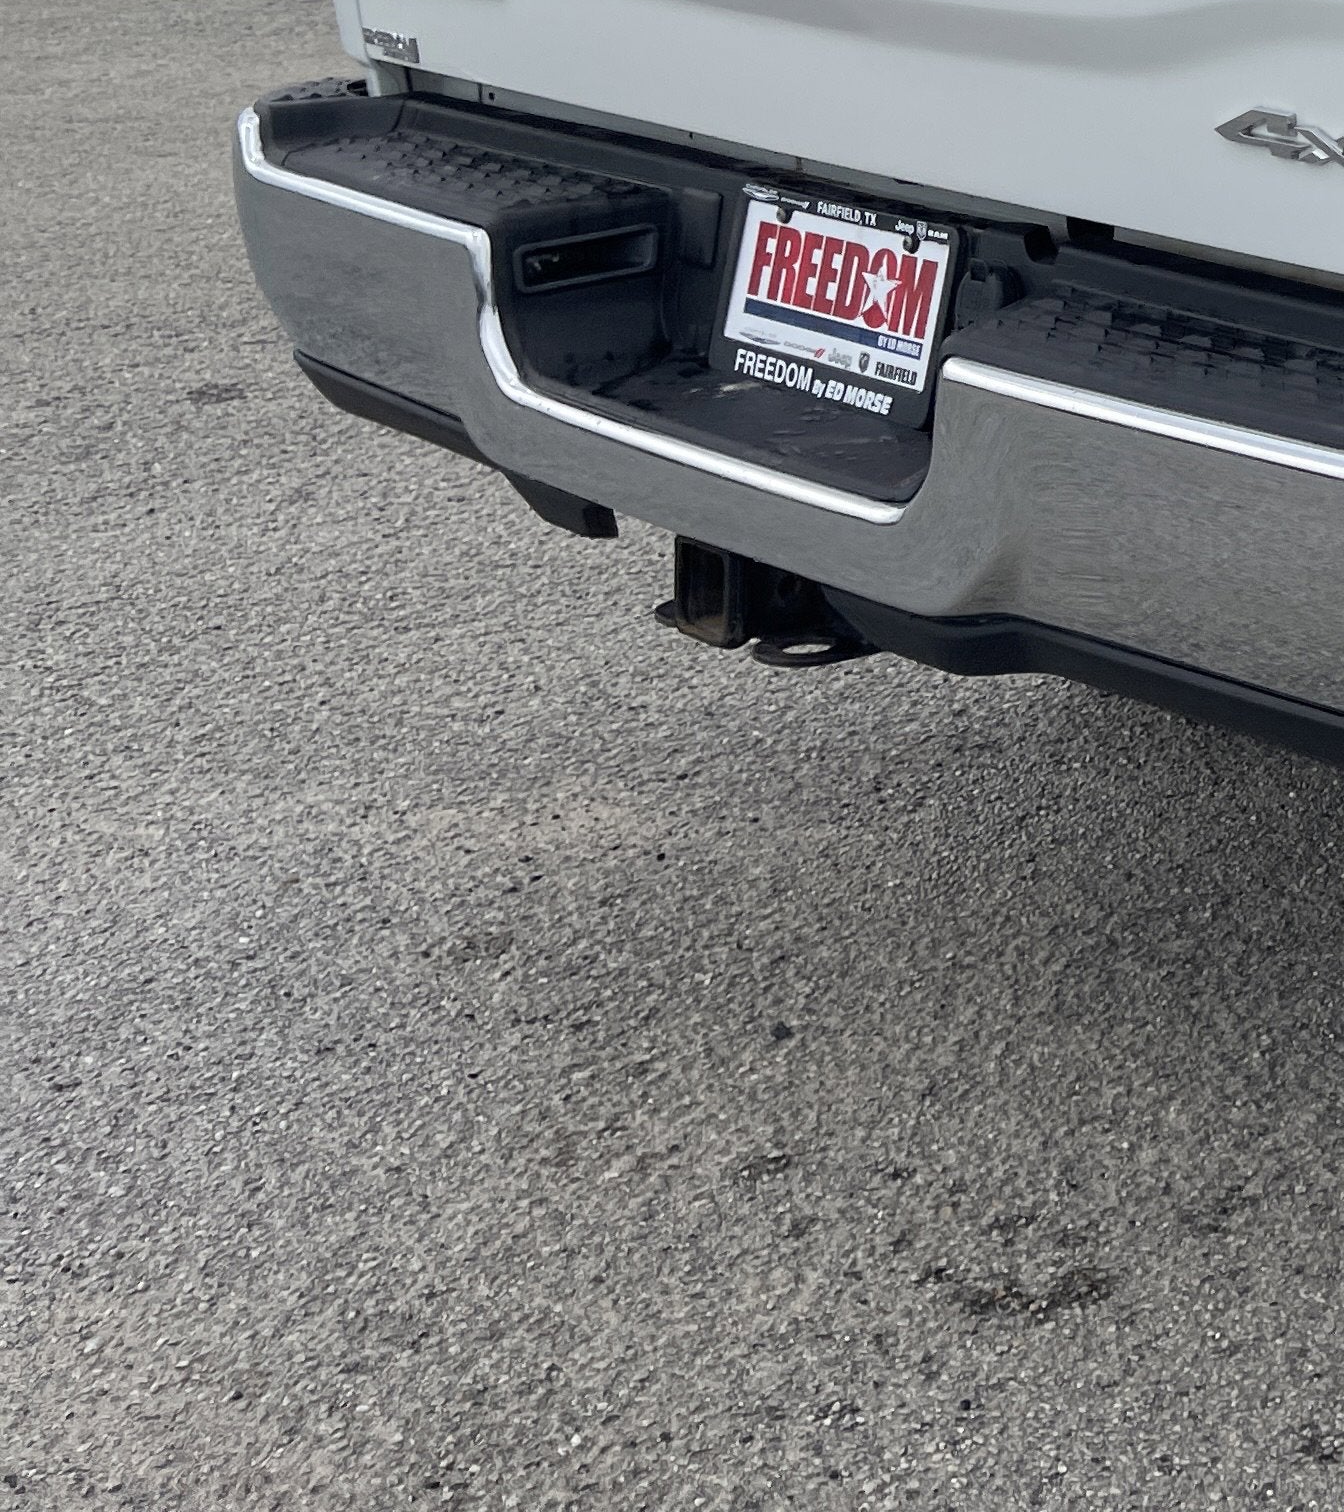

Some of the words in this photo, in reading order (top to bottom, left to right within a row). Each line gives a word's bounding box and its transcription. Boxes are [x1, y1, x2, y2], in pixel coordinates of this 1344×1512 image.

[816, 201, 863, 226] FAIRFIELD,
[864, 211, 877, 227] TX
[894, 219, 915, 235] Jeep
[928, 229, 948, 240] RAM
[747, 221, 938, 340] FREEDOM
[828, 348, 853, 369] Jeep
[734, 349, 813, 391] FREEDOM
[825, 381, 844, 402] ED
[843, 386, 893, 415] MORSE
[874, 361, 918, 386] FAIRFIELD
